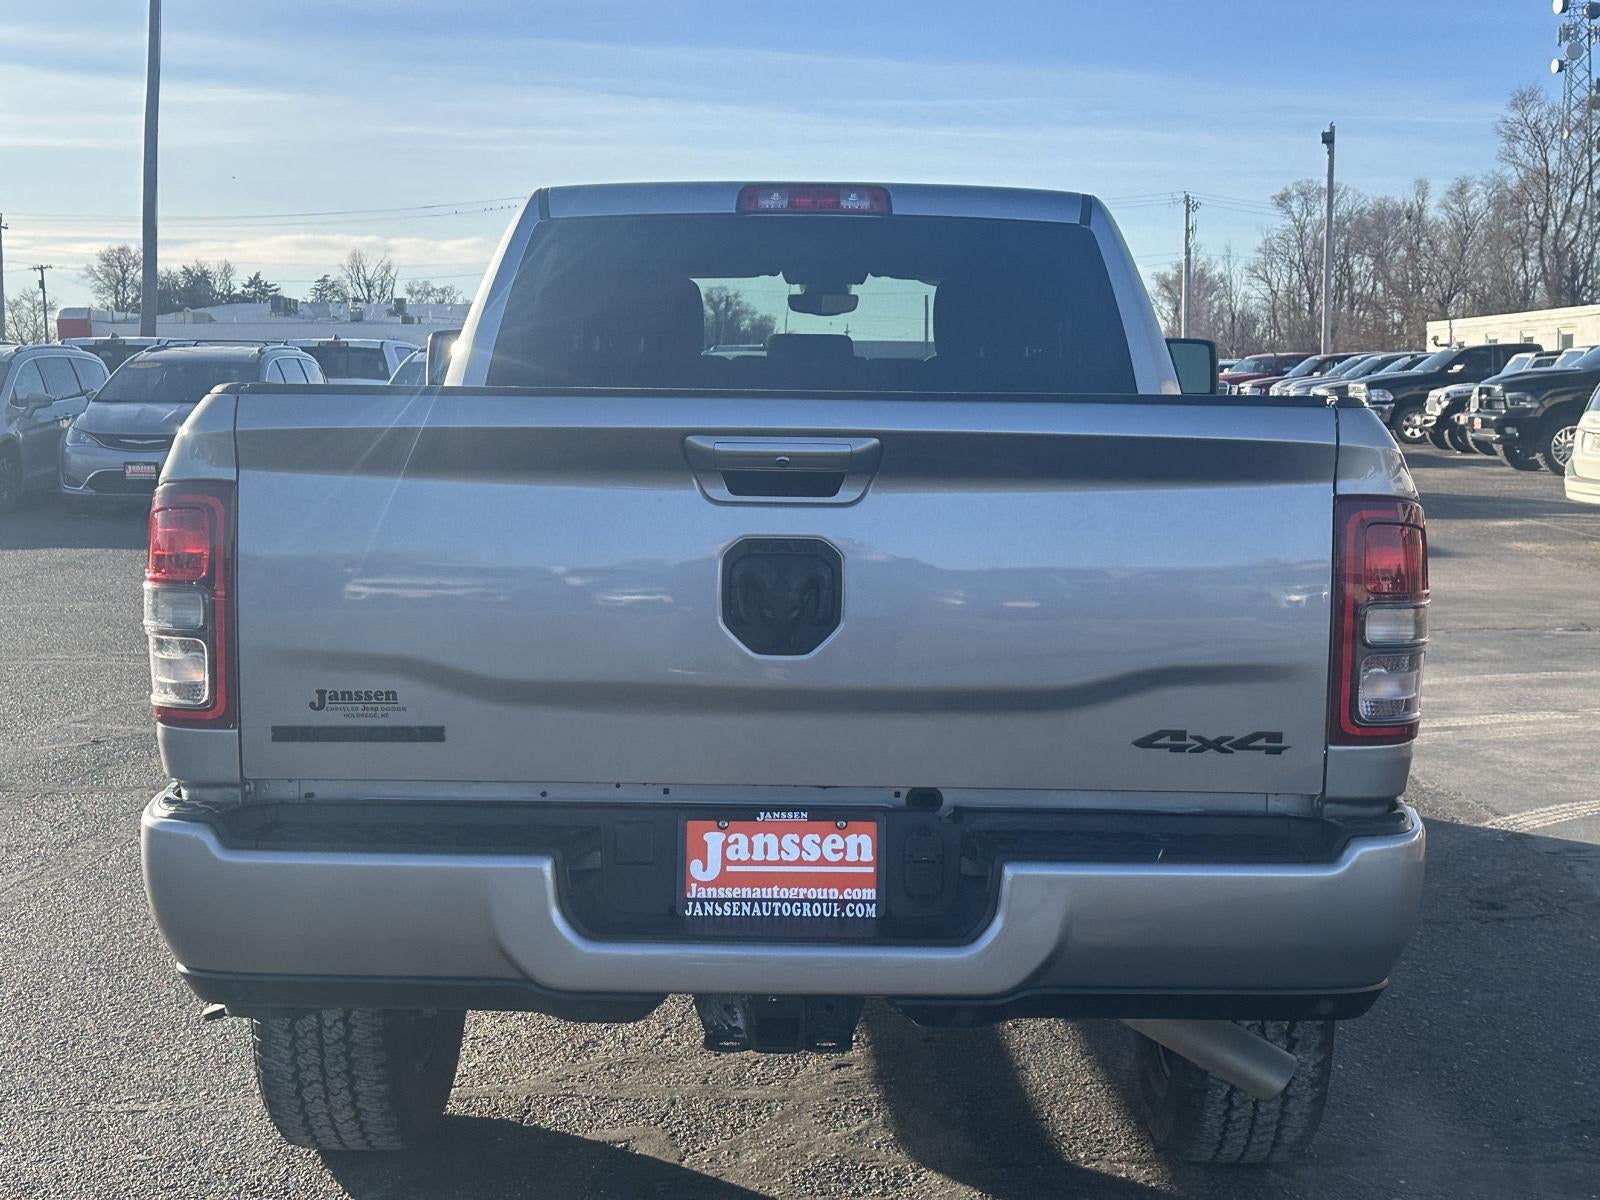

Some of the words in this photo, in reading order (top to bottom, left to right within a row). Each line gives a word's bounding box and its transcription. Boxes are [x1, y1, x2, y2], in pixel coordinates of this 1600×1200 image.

[309, 689, 398, 711] Janssen
[1131, 729, 1292, 755] 4x4
[757, 811, 808, 821] JANSSEN
[690, 832, 873, 881] Janssen
[686, 883, 877, 900] Janssenautogroup.com
